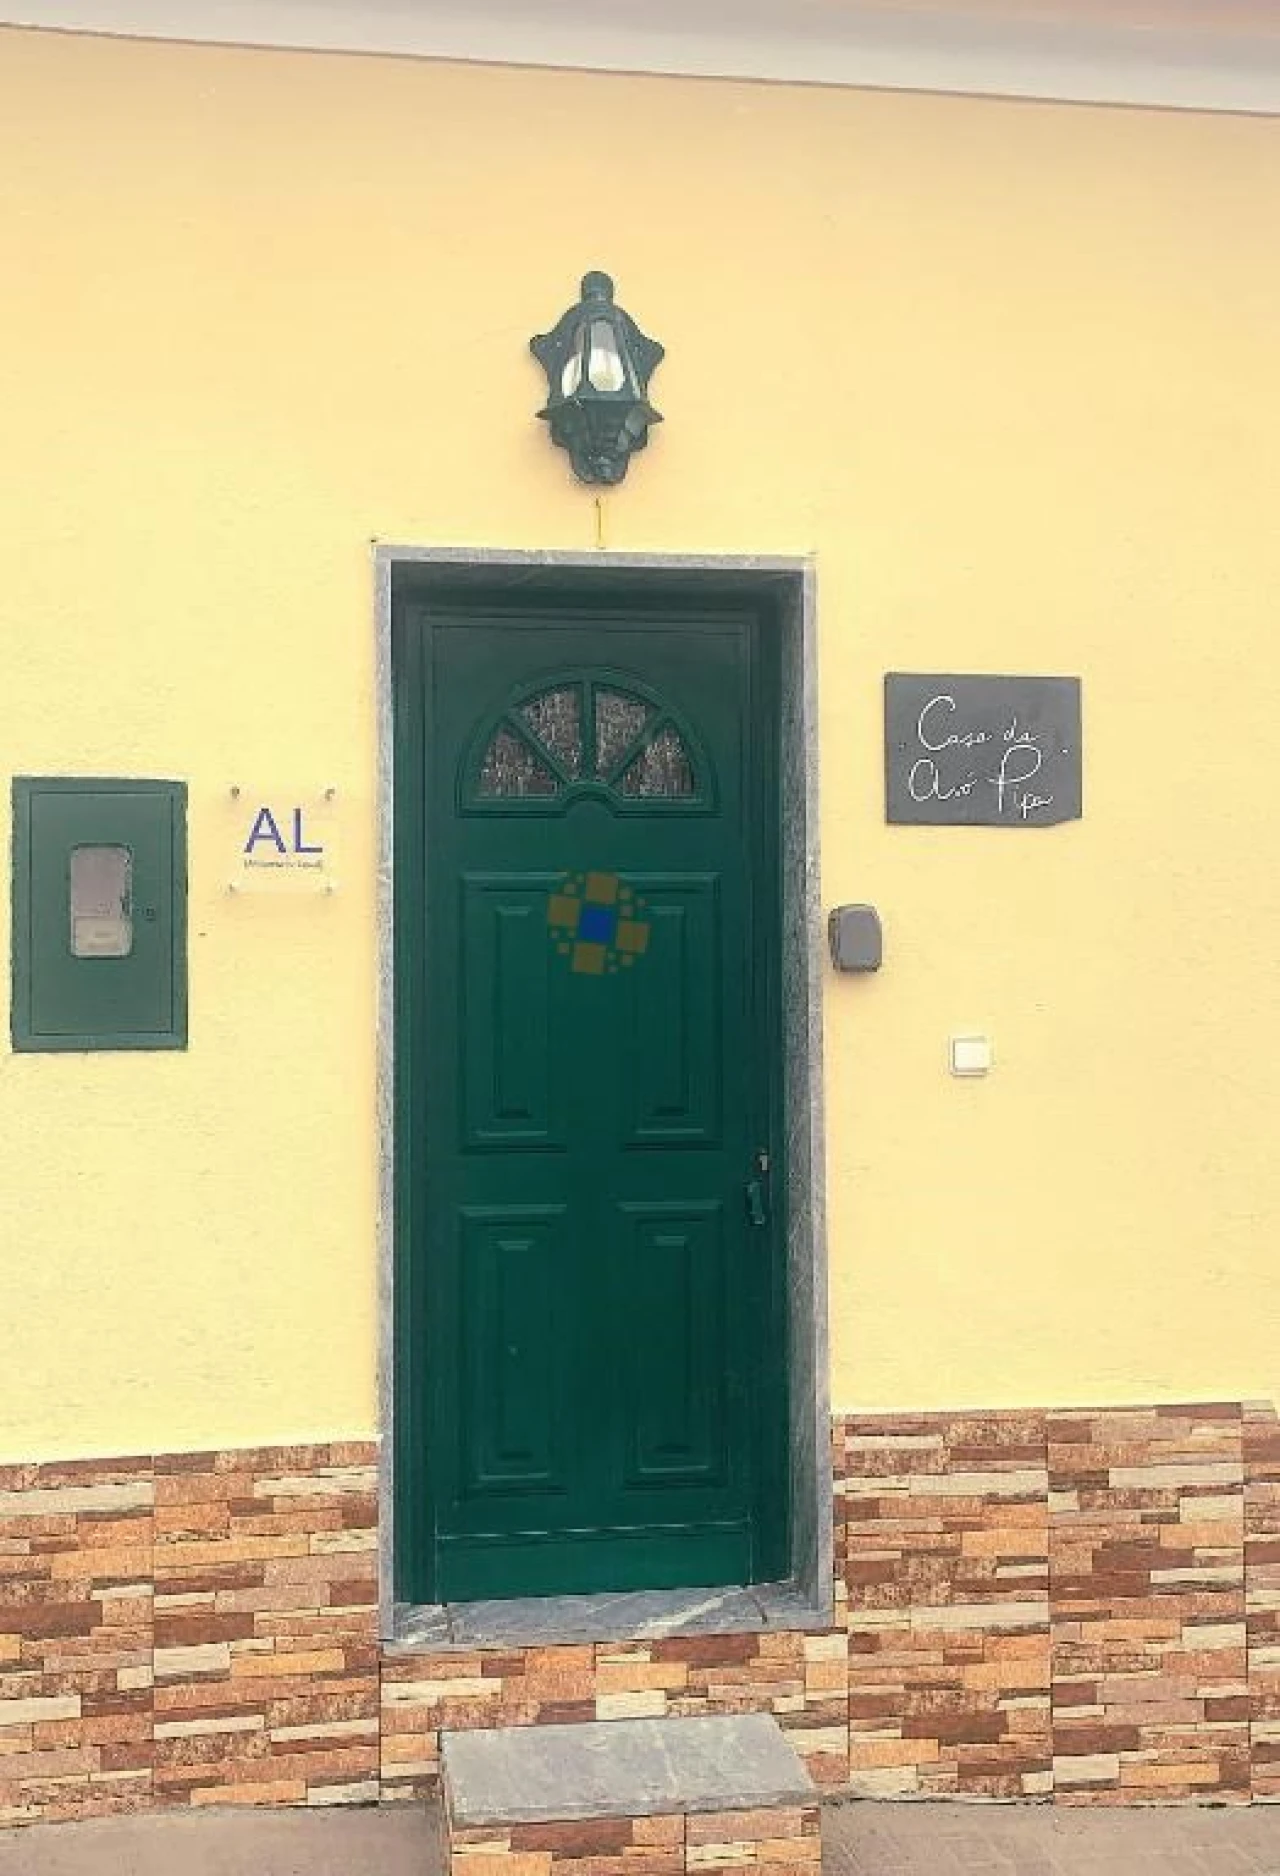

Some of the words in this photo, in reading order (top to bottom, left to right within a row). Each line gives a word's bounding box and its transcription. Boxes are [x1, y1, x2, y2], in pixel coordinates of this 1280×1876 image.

[918, 695, 992, 751] Casa
[1003, 716, 1040, 743] da
[243, 807, 323, 853] AL
